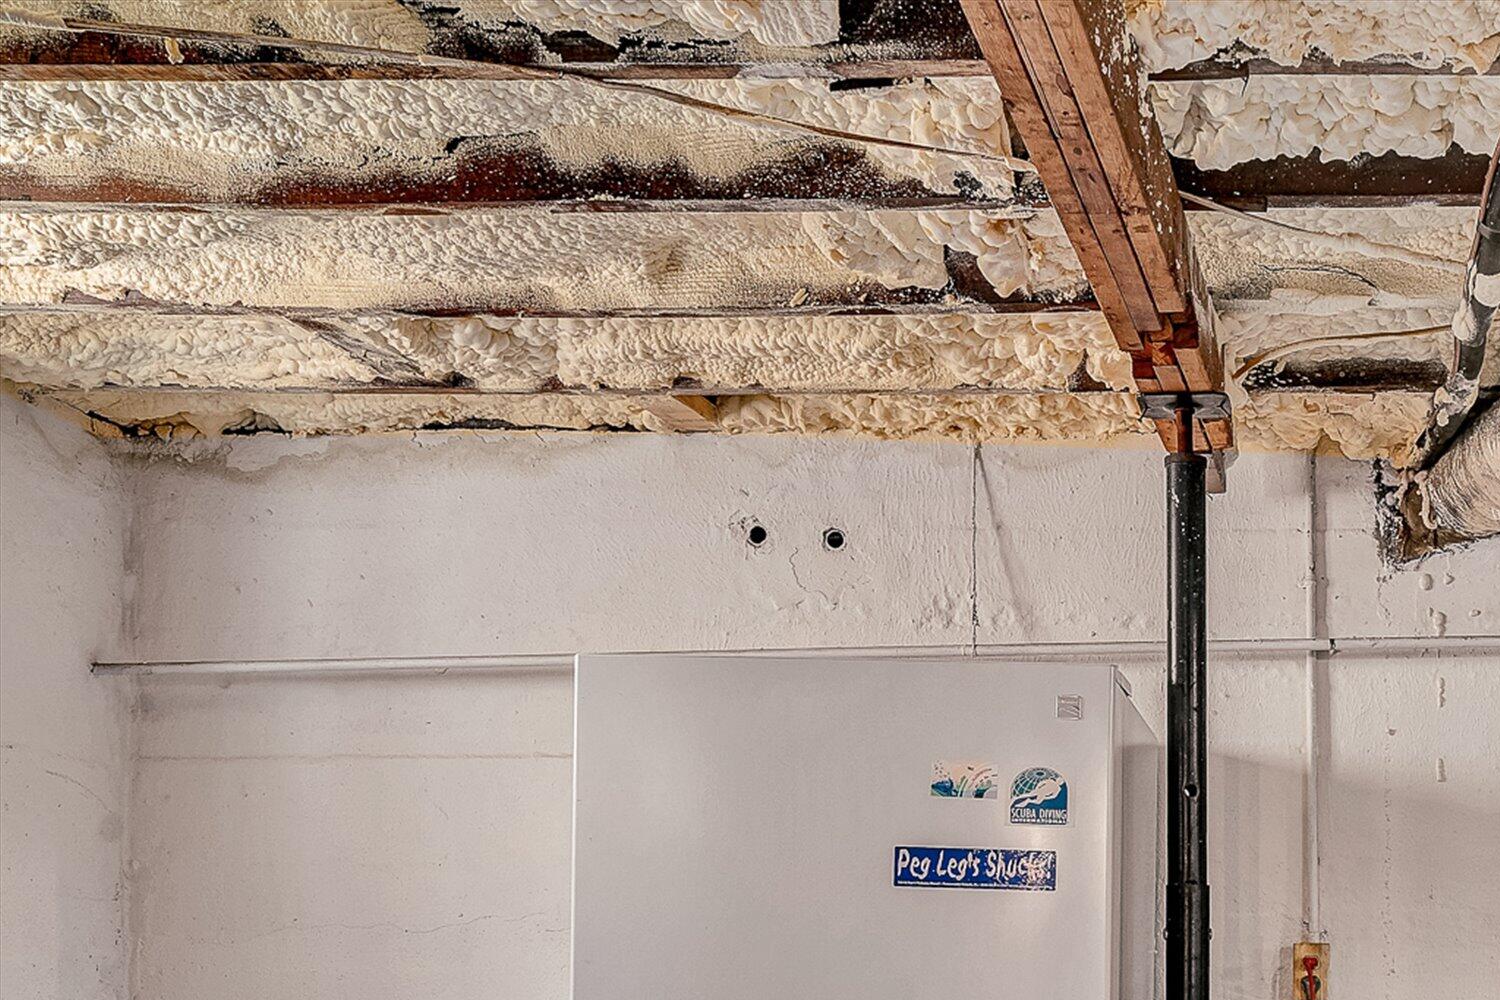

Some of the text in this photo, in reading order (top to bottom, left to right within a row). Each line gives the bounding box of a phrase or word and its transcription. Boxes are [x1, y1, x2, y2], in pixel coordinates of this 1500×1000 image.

[1010, 807, 1067, 820] SCUBA DIVING
[897, 848, 931, 880] Peg
[936, 850, 980, 881] Leg's
